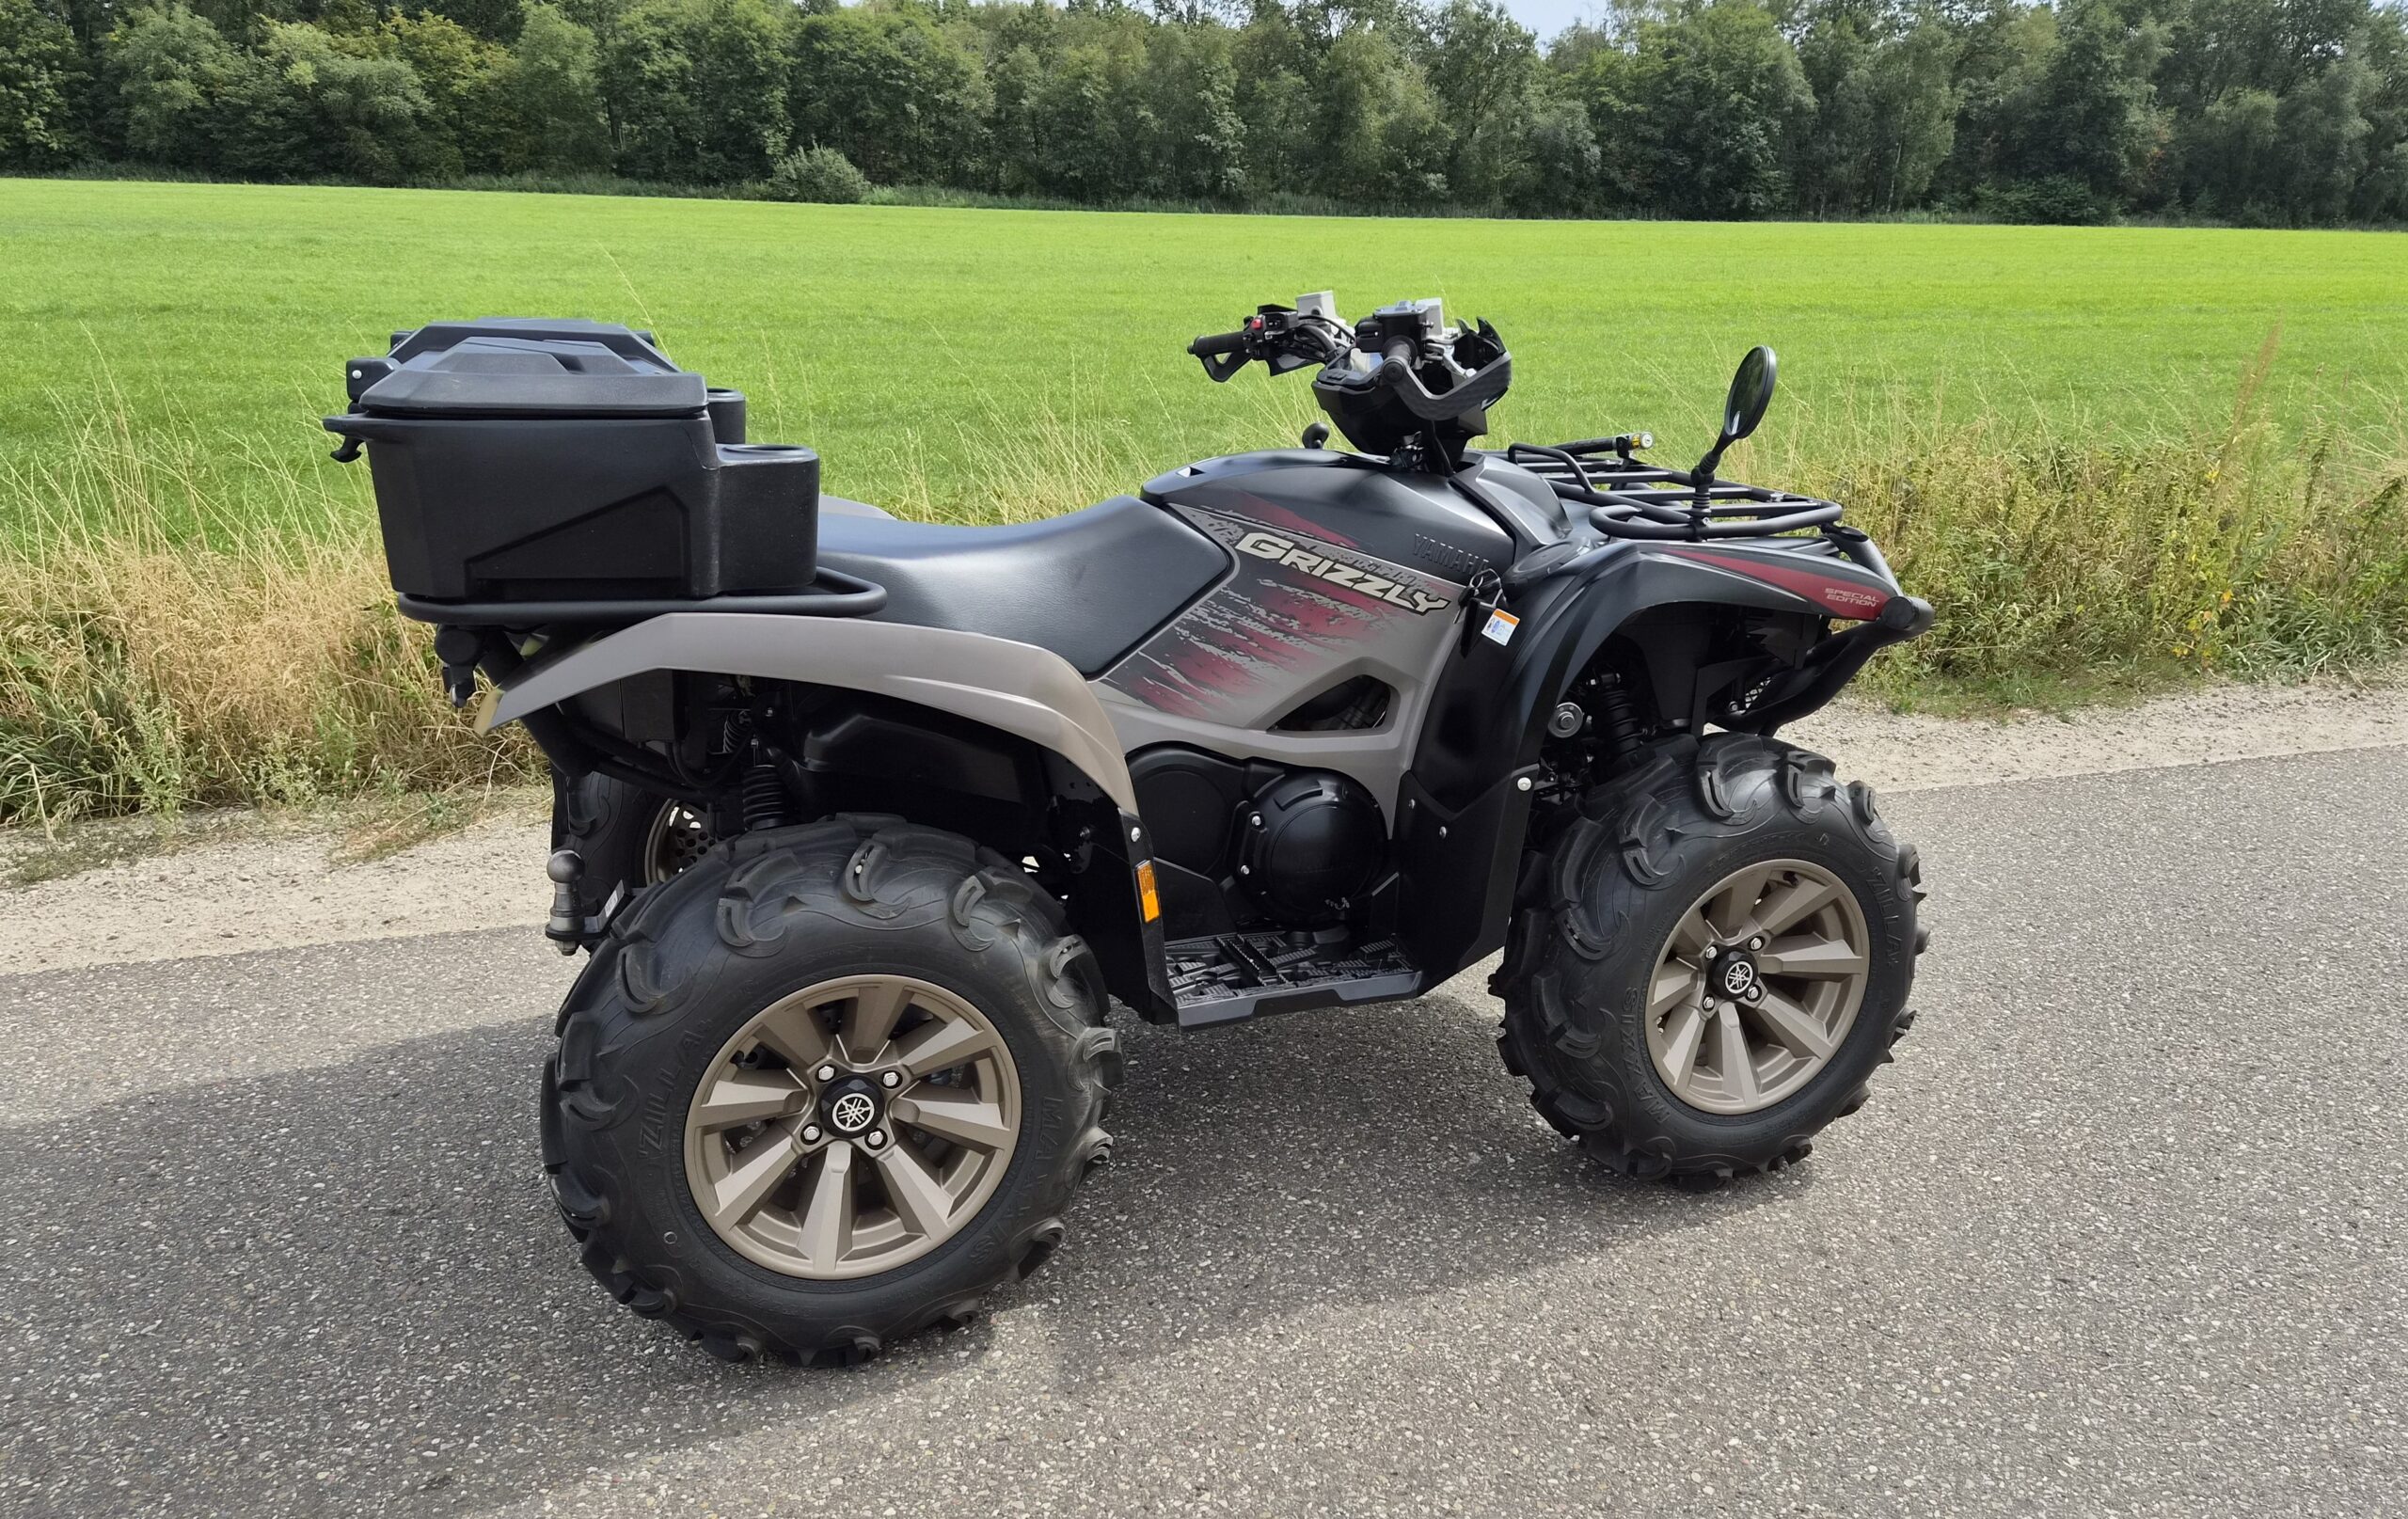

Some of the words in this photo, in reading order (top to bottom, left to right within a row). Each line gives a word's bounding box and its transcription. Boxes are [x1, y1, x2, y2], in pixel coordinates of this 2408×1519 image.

[1234, 531, 1451, 615] GRIZZLY
[1413, 533, 1491, 577] YAMAHA
[1825, 587, 1879, 603] SPECIAL
[1826, 594, 1877, 608] EDITION
[1619, 986, 1671, 1125] MAXXIS
